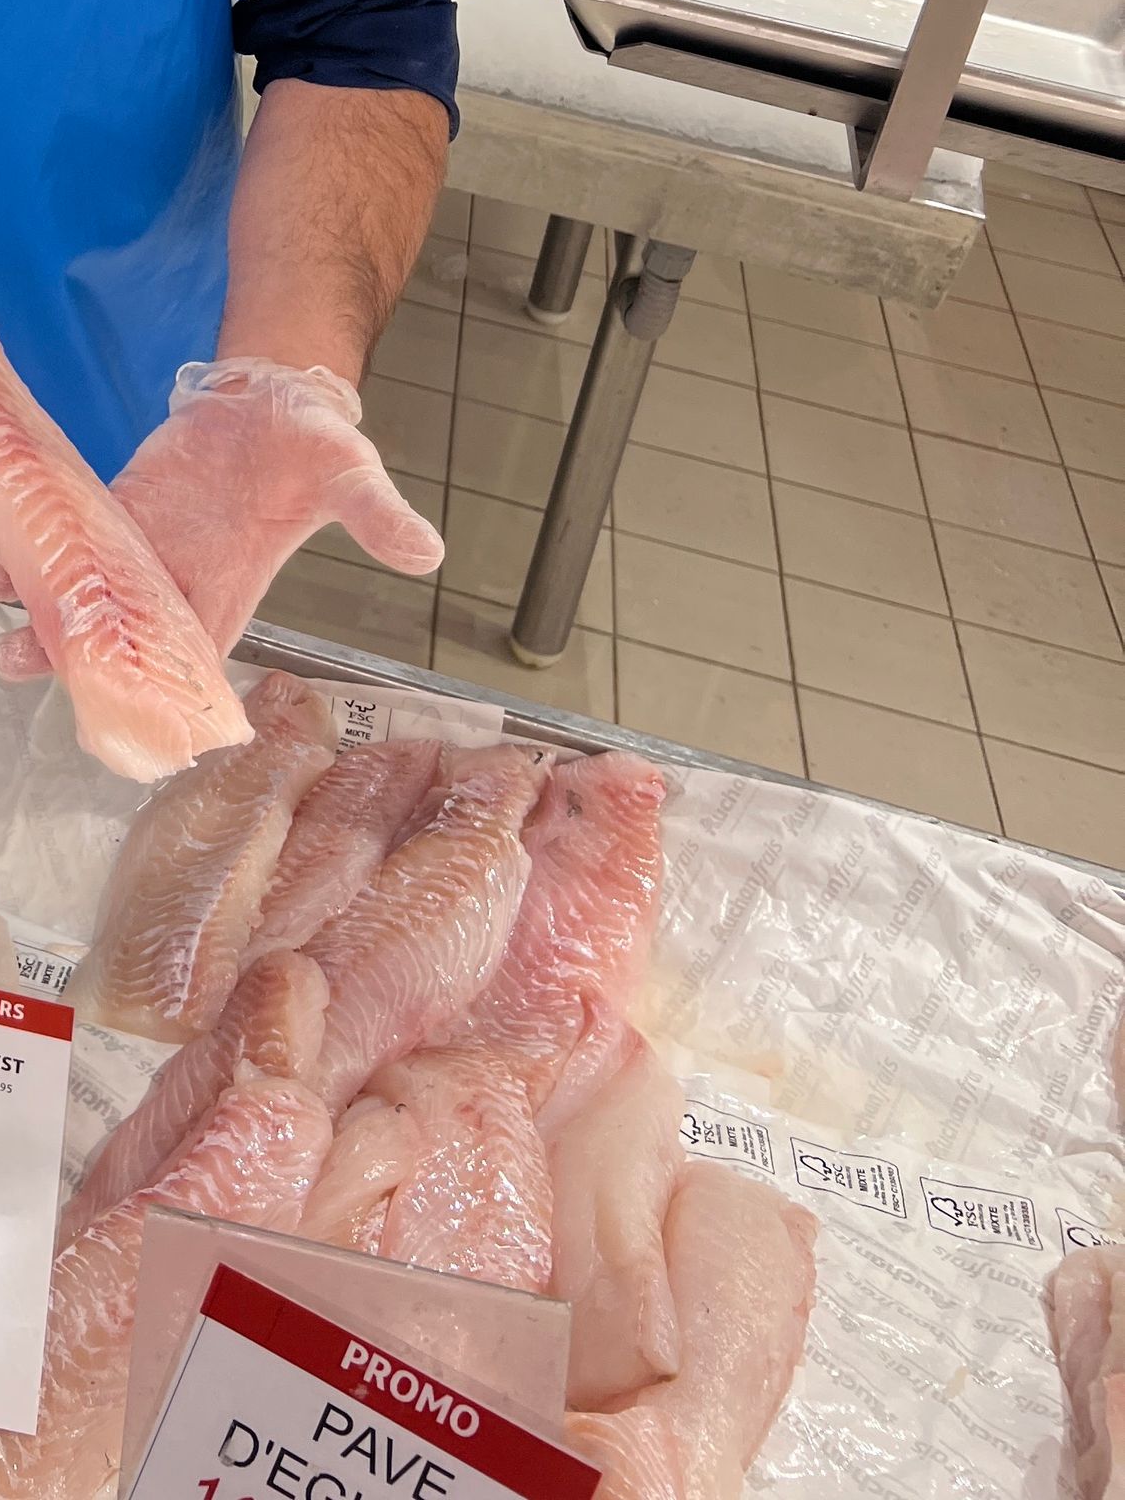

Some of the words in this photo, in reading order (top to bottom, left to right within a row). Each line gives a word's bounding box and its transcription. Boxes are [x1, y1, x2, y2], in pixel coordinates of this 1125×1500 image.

[348, 711, 375, 724] FSC
[345, 728, 371, 740] MIXTE
[703, 1121, 716, 1145] FSC
[727, 1126, 737, 1148] MIXTE
[832, 1163, 846, 1187] FSC
[856, 1168, 868, 1193] MIXTE
[964, 1201, 979, 1228] FSC
[989, 1206, 1001, 1234] MIXTE
[340, 1339, 481, 1439] PROMO
[216, 1419, 363, 1500] D'EG
[312, 1402, 457, 1500] PAVE
